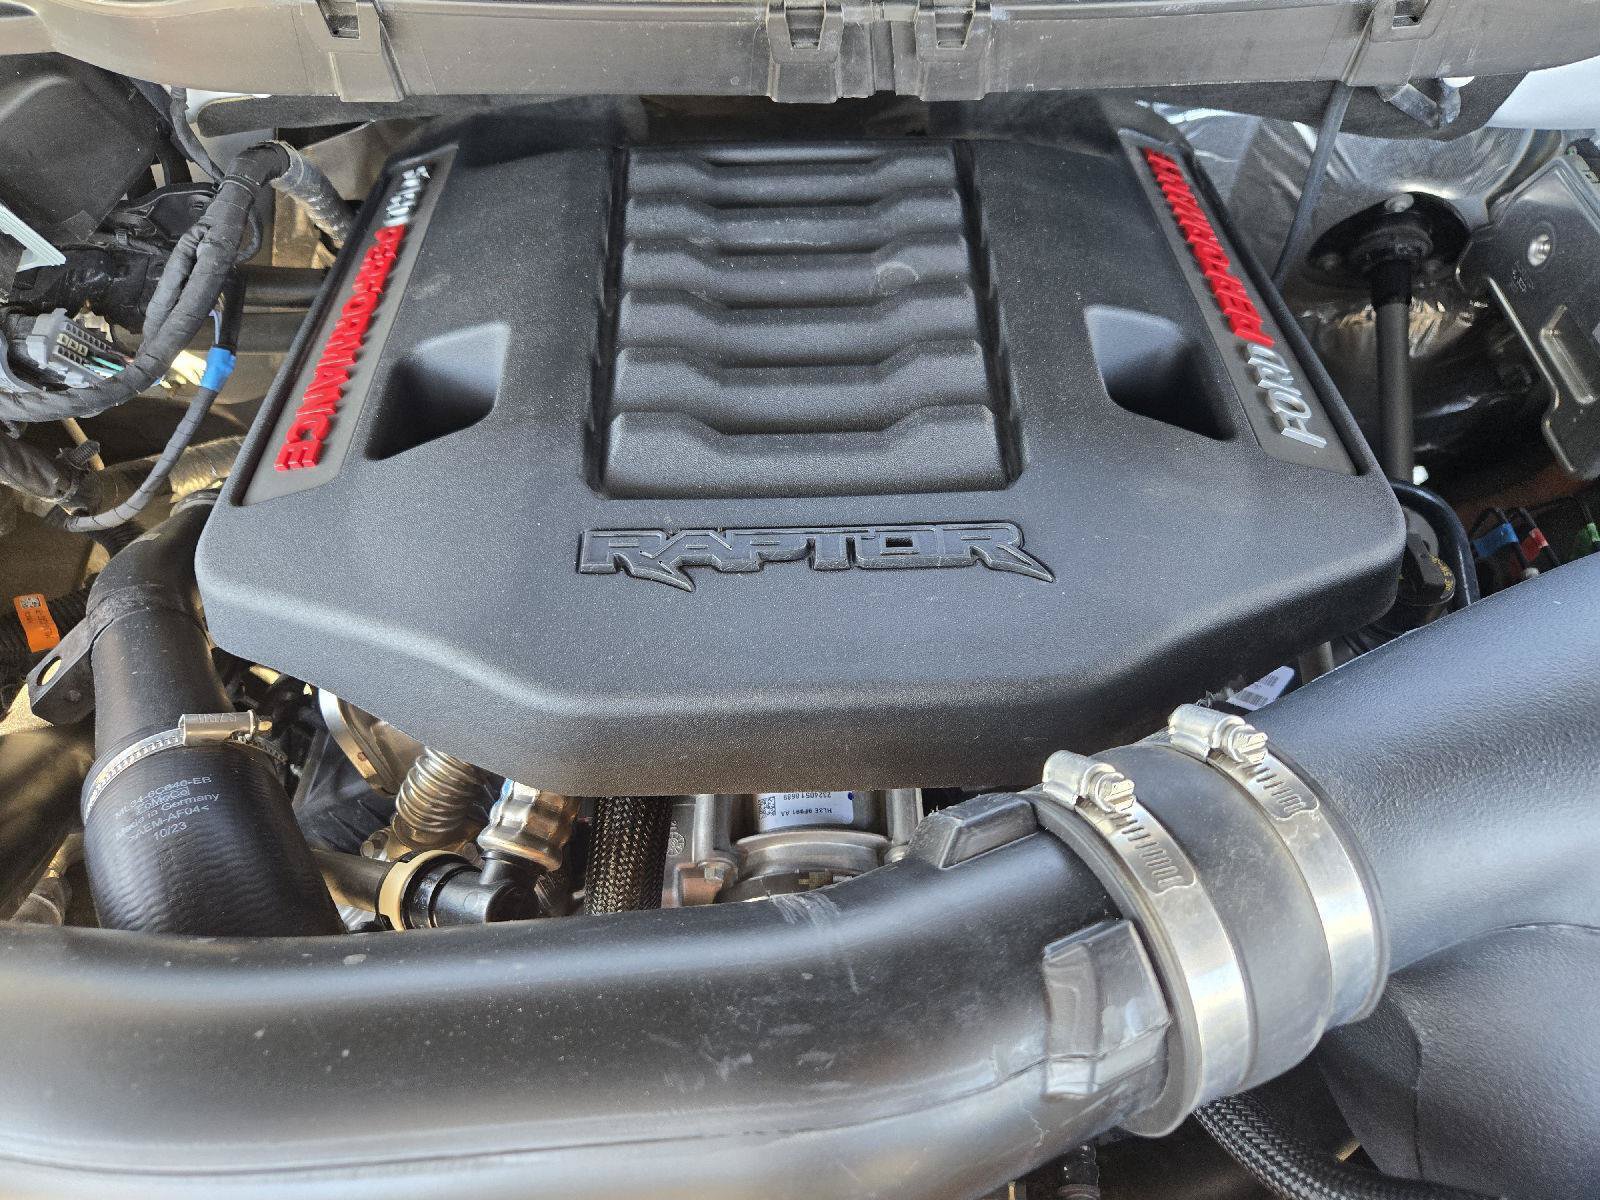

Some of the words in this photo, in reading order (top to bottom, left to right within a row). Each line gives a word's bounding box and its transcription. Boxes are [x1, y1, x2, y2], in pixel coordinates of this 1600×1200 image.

[1147, 147, 1274, 348] PERFORMANCE
[274, 224, 405, 471] PERFORMANCE
[1247, 342, 1327, 449] FORD
[577, 520, 1055, 593] RAPTOR
[153, 821, 187, 840] 10/23
[161, 793, 219, 811] Germany
